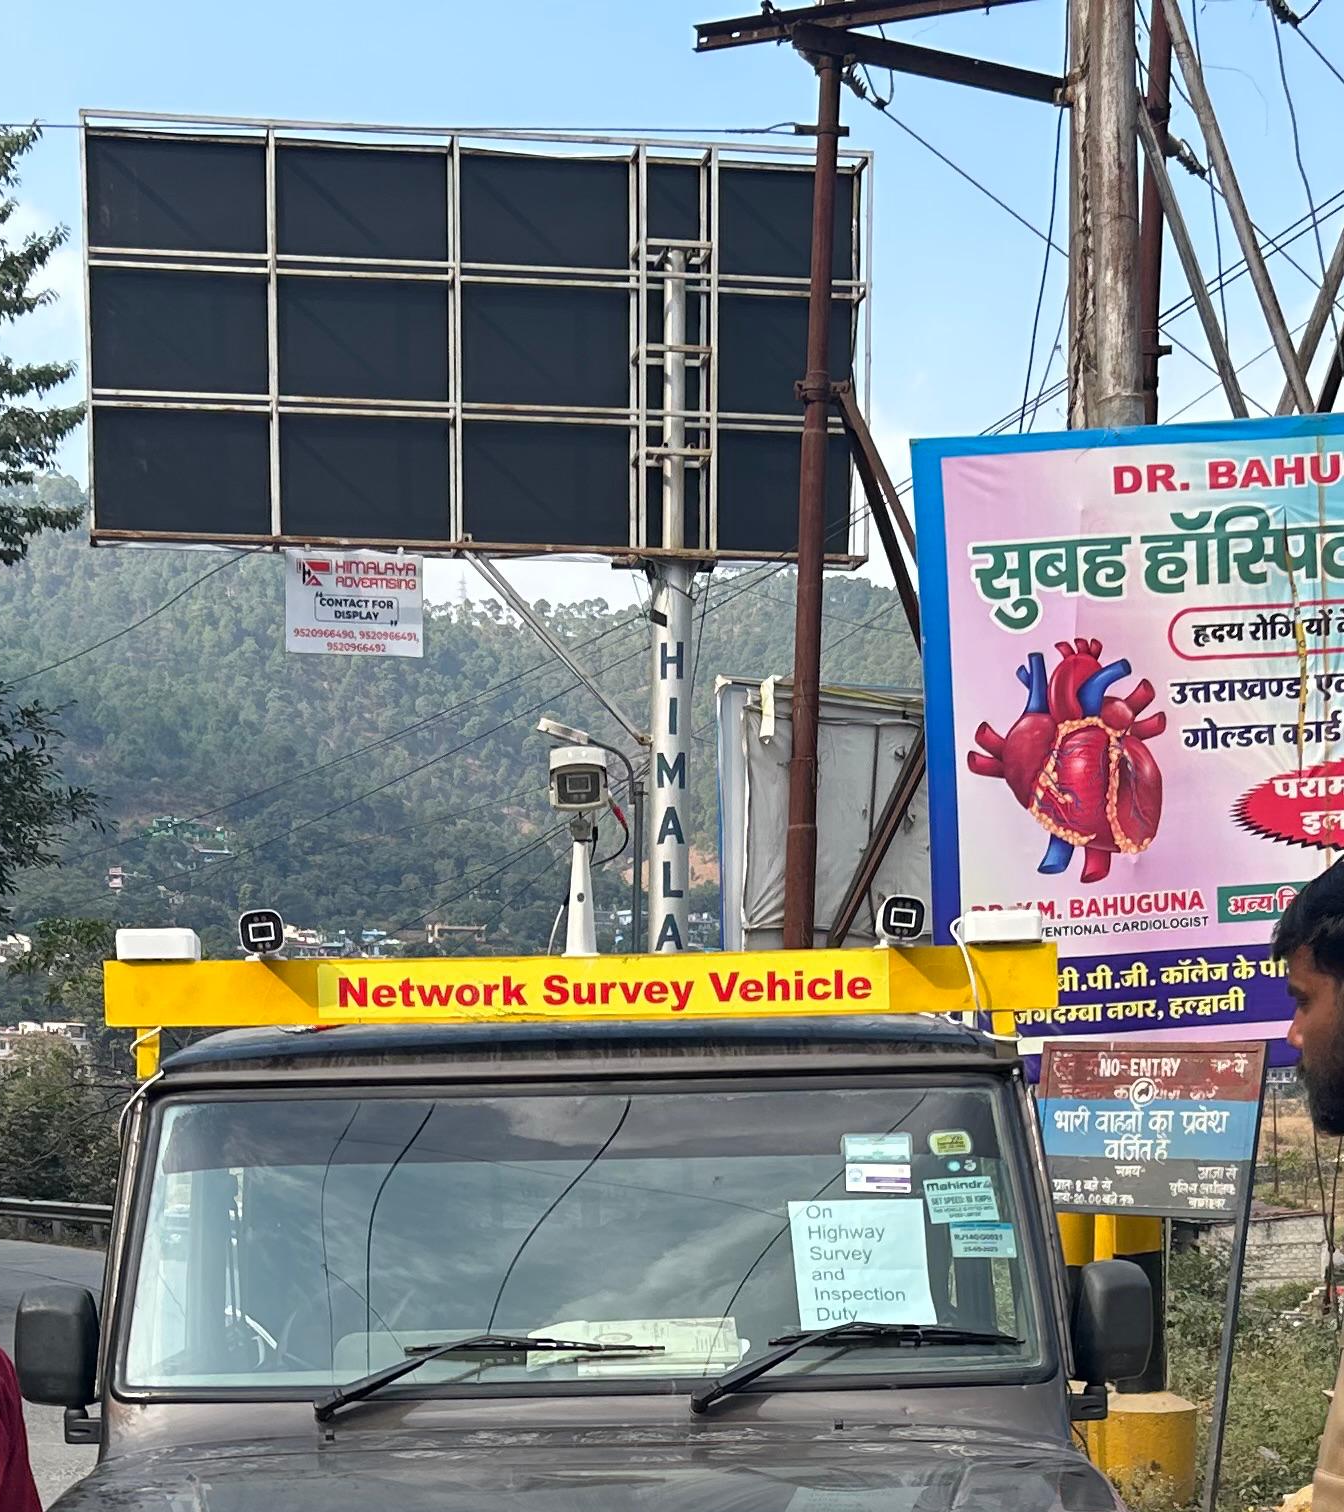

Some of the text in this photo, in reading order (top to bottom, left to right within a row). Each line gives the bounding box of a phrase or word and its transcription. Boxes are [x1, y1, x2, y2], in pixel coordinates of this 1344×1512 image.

[1112, 463, 1190, 494] DR.
[335, 559, 417, 576] HIMALAYA
[971, 535, 1132, 630] सुबह
[319, 597, 394, 609] CONTACT FOR
[334, 609, 380, 621] DISPLAY
[1170, 676, 1308, 705] उत्तराखण्ड
[1182, 717, 1277, 750] गोल्डन
[1280, 710, 1343, 746] कार्ड
[1070, 890, 1205, 920] BAHUGUNA
[1228, 893, 1273, 914] अन्य
[1112, 916, 1209, 934] CARDIOLOGIST
[1161, 959, 1230, 986] कॉलेज
[1232, 954, 1256, 980] के
[1260, 957, 1290, 979] पा
[336, 968, 874, 1013] Network Survey Vehicle
[1107, 998, 1164, 1022] नगर,
[1167, 986, 1246, 1018] हल्द्वानी
[1099, 1057, 1181, 1078] NO-ENTRY
[1053, 1105, 1091, 1134] भारी
[1148, 1110, 1174, 1132] का
[1179, 1104, 1230, 1135] प्रवेश
[1103, 1134, 1154, 1162] वर्जित
[806, 1204, 833, 1220] On
[807, 1224, 886, 1244] Highway
[809, 1246, 873, 1265] Survey
[811, 1267, 845, 1282] and
[814, 1287, 907, 1304] Inspection
[816, 1307, 858, 1323] Duty
